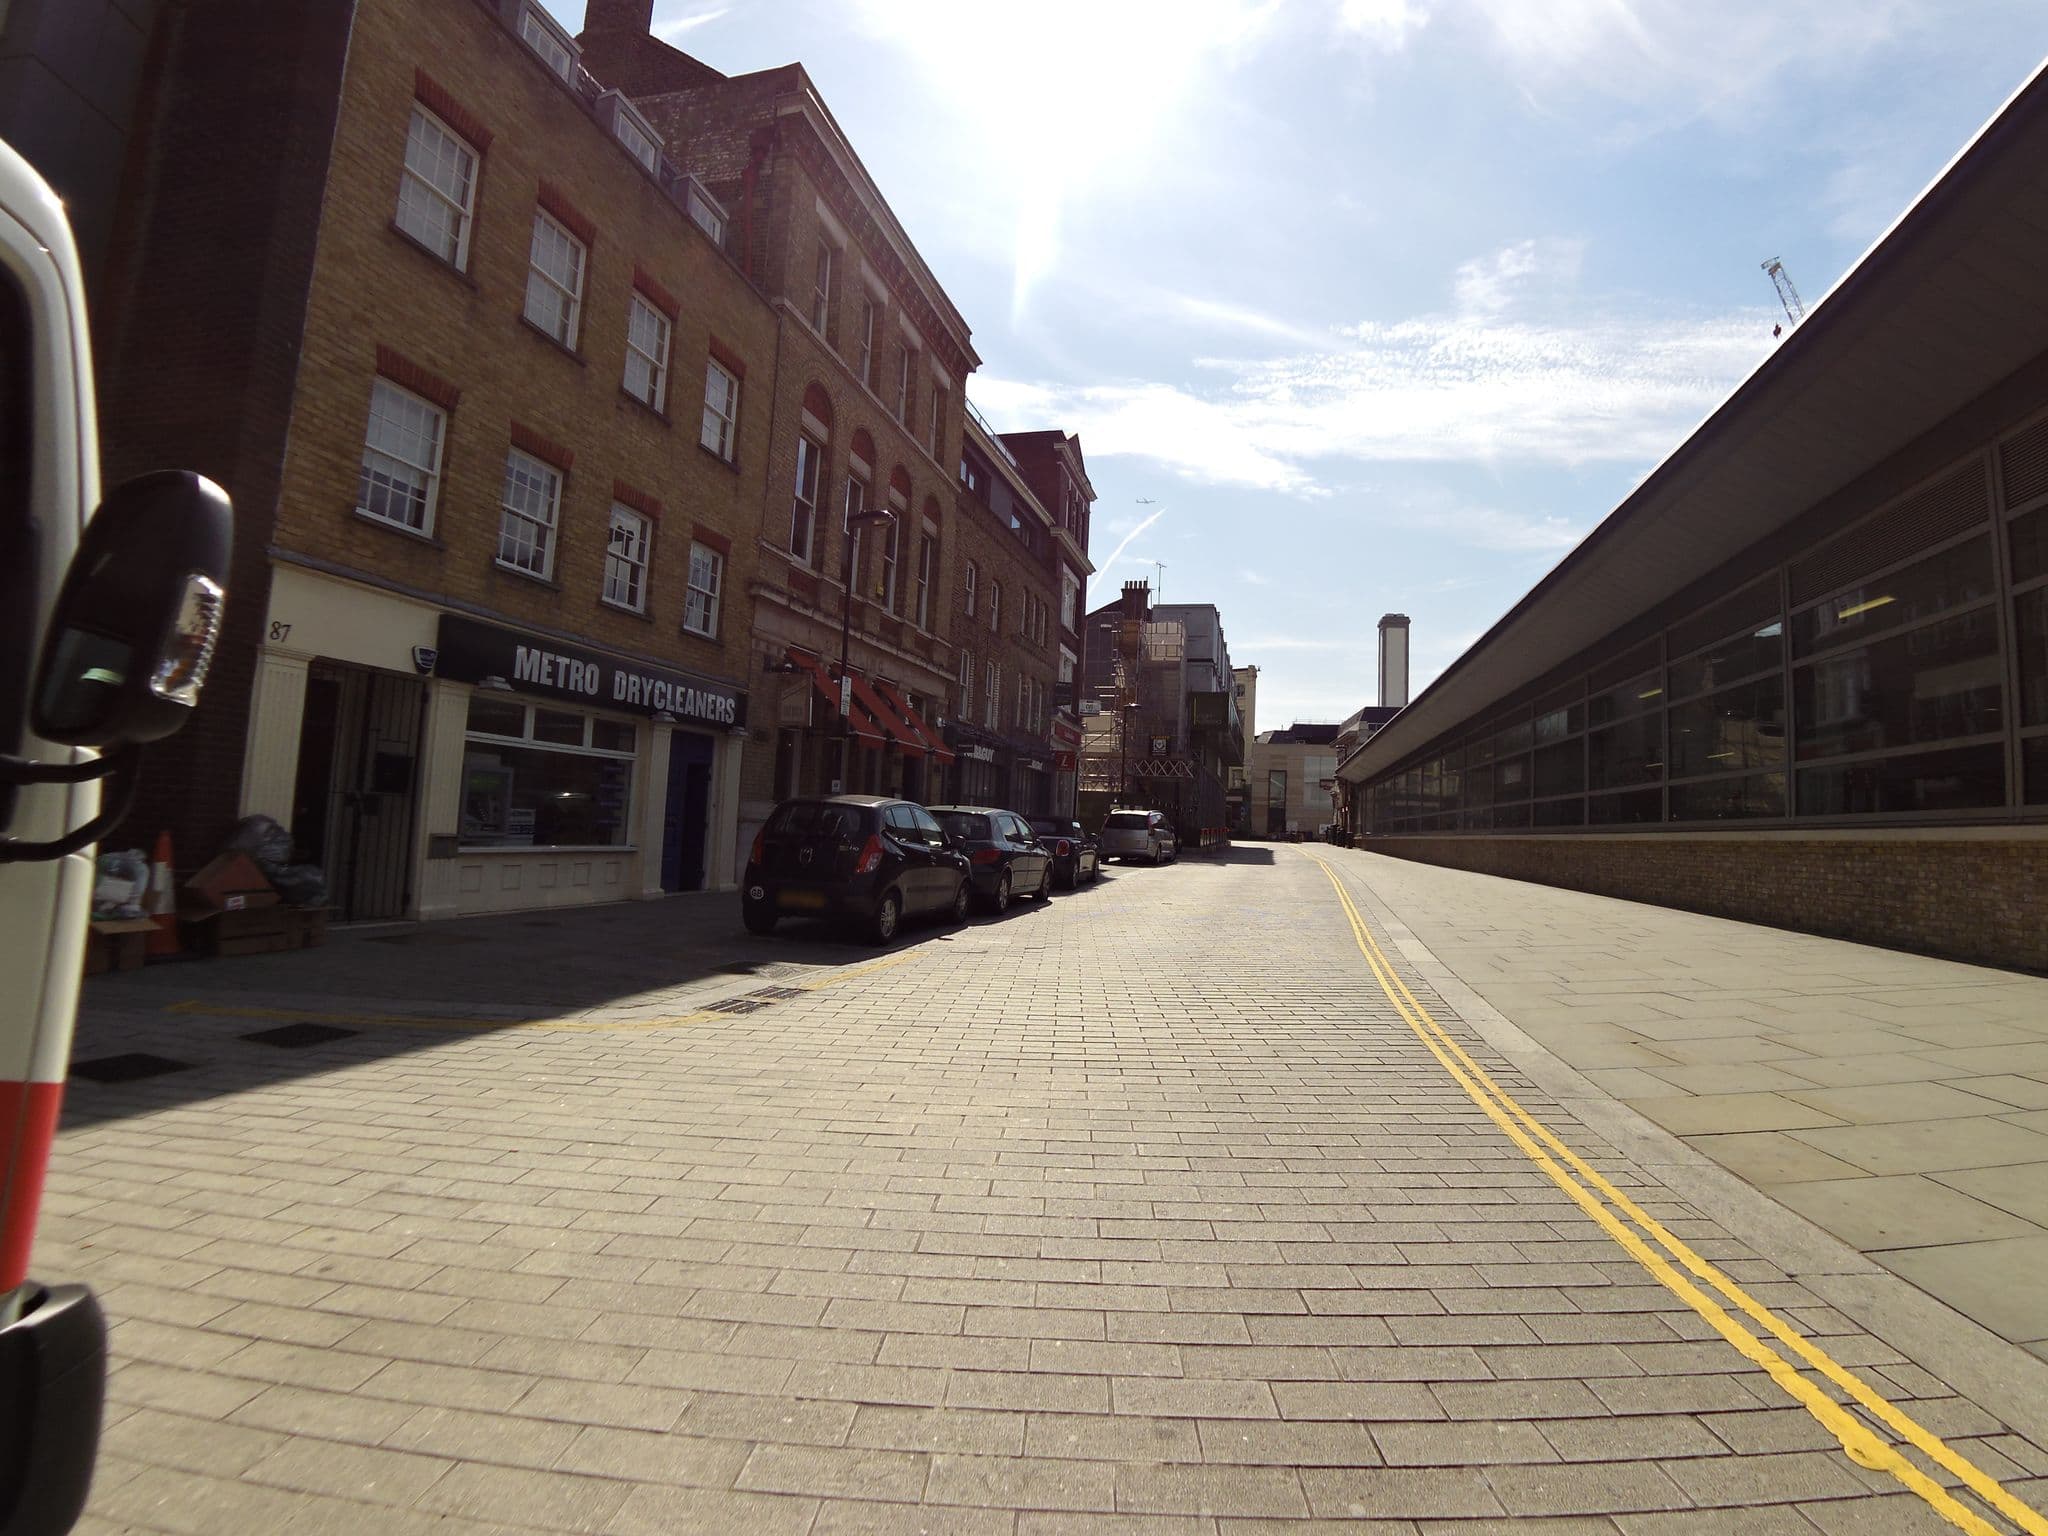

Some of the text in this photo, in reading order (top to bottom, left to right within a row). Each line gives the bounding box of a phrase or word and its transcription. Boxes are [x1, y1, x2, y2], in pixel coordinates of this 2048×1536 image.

[270, 620, 292, 643] 87
[514, 646, 736, 724] METRO DRYCLEANERS
